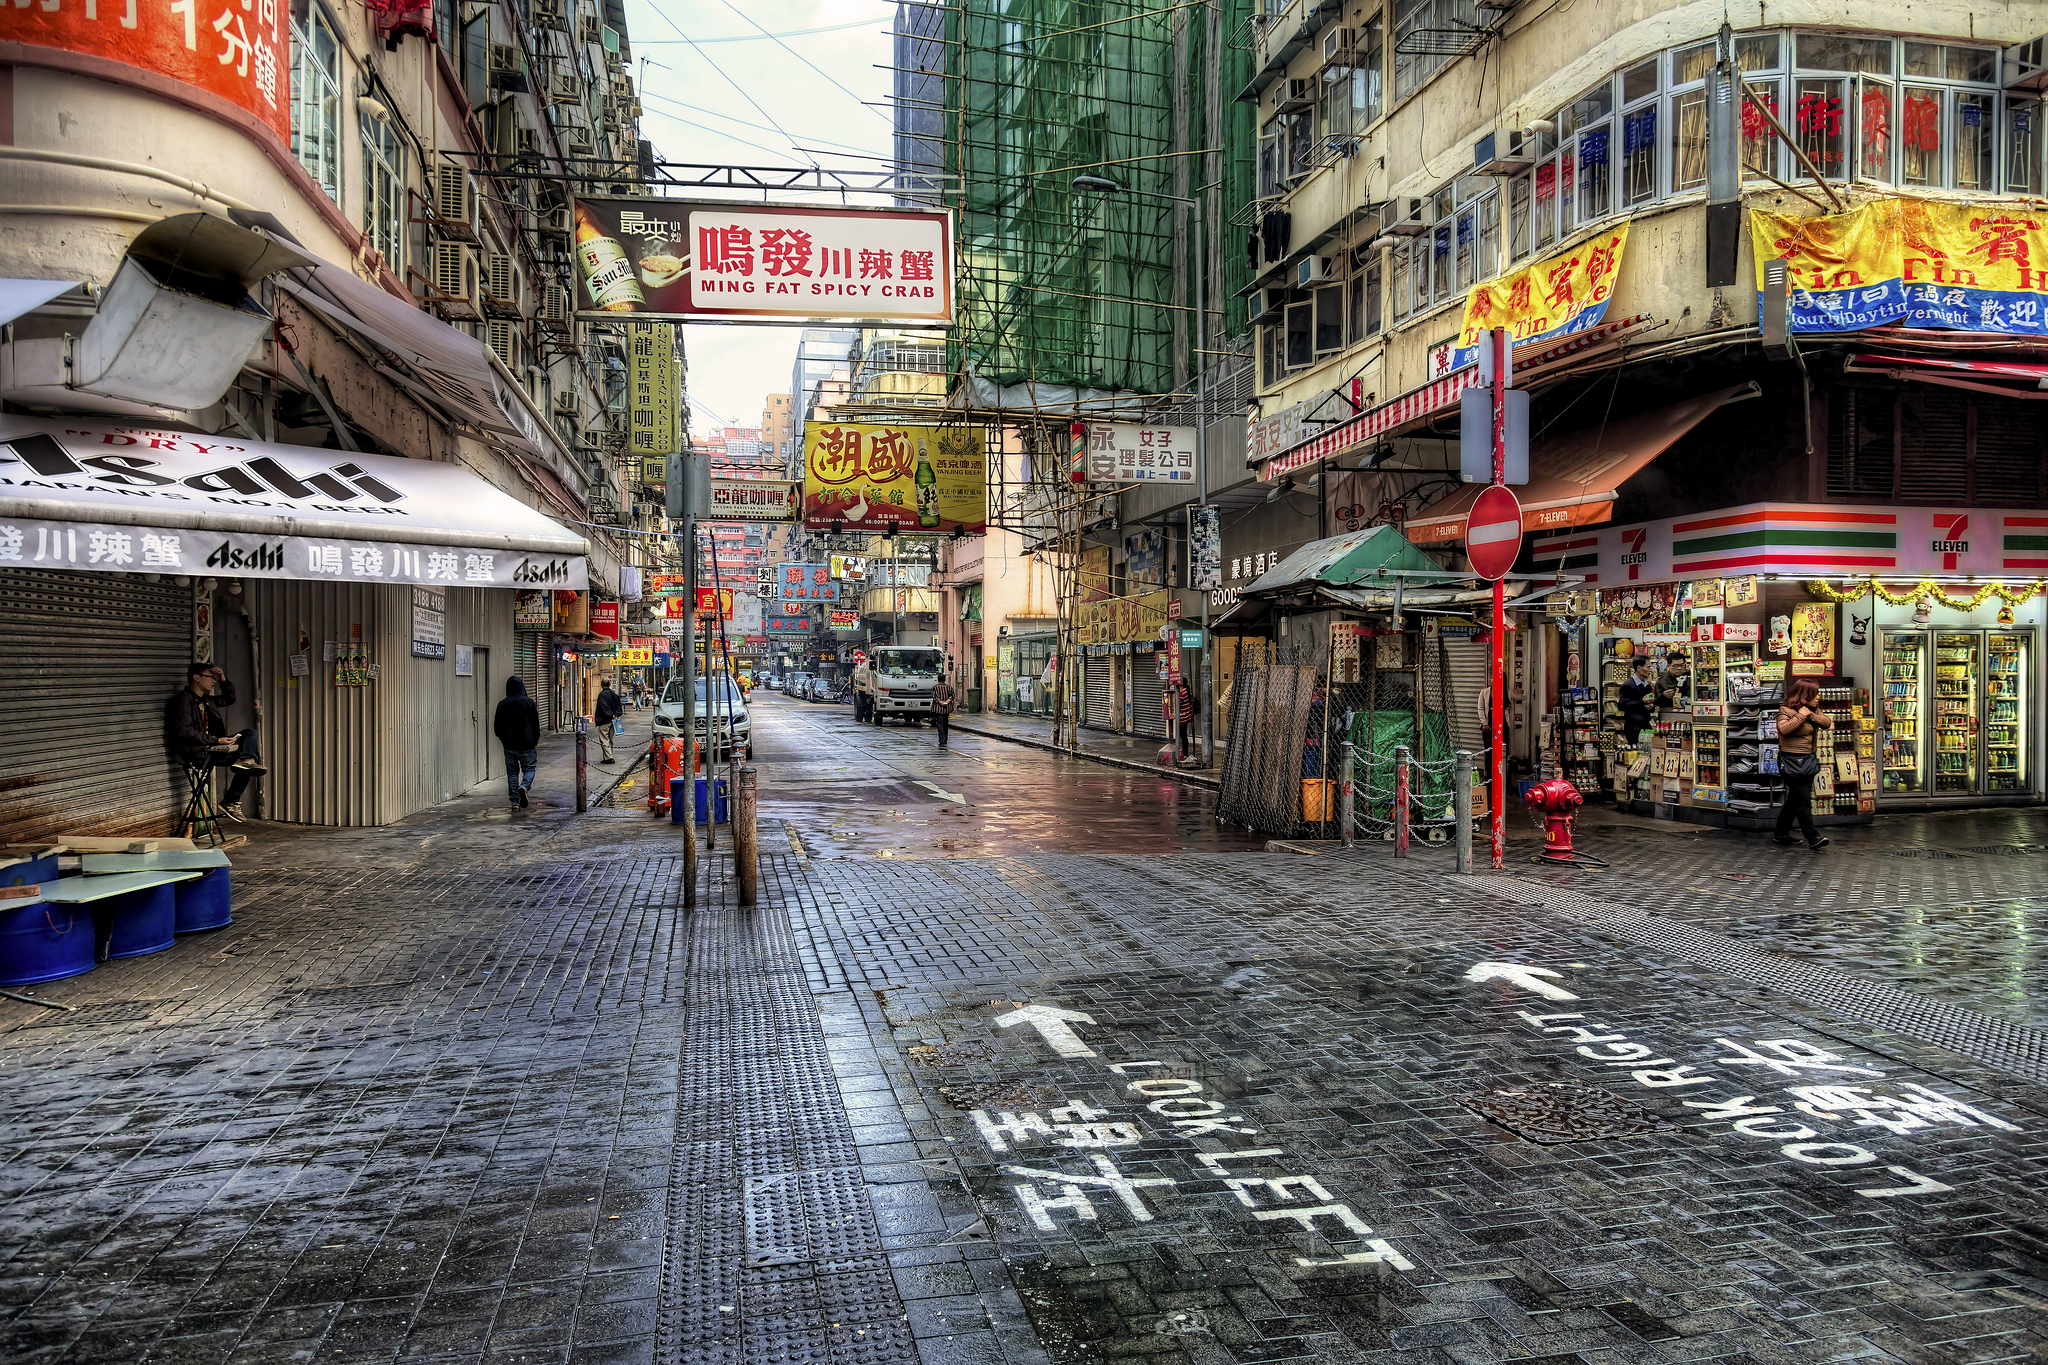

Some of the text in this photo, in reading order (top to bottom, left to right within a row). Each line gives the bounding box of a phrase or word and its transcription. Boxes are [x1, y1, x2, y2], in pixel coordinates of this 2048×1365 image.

[1903, 257, 1979, 286] Tin
[701, 280, 935, 299] MING FAT SPICY CRAB
[1515, 314, 1548, 339] Tin
[114, 427, 183, 440] SUPER
[1139, 430, 1173, 448] 女子
[1091, 427, 1116, 480] 永安
[1118, 449, 1193, 469] 理髮公司
[311, 504, 410, 516] BEER
[713, 488, 784, 506] 亞龍咖喱
[206, 540, 284, 571] Asahi
[1231, 551, 1278, 580] 豪境酒店
[512, 557, 569, 584] Asahi
[761, 619, 810, 631] 興火鍋
[1845, 761, 1852, 776] 9
[1862, 770, 1871, 785] 13
[1816, 775, 1827, 791] 13
[1516, 1010, 1717, 1088] RIGHT
[1107, 1060, 1258, 1139] LOOK
[1714, 1037, 2025, 1136] 望右
[1683, 1095, 1956, 1199] LOOK
[969, 1099, 1178, 1232] 望左
[1194, 1148, 1417, 1271] LEFT
